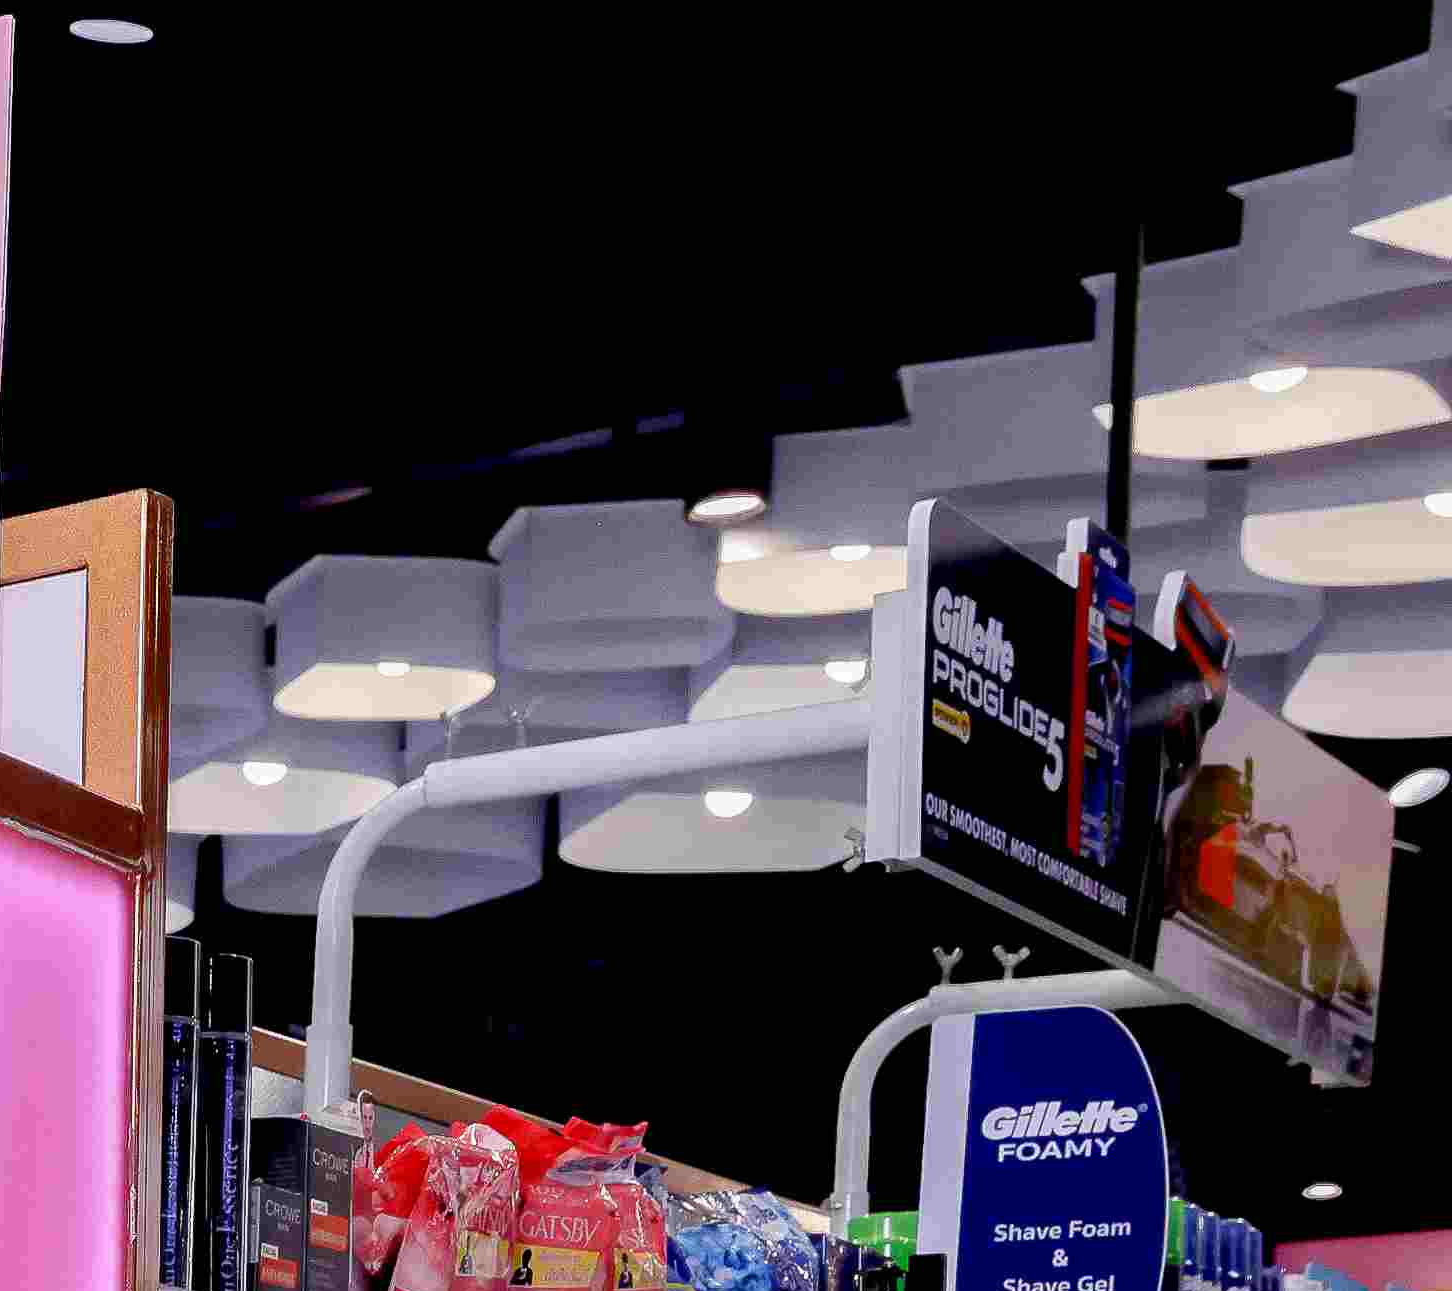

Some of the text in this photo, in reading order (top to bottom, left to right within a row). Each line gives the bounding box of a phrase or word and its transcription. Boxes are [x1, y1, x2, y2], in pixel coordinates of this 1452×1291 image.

[932, 586, 1014, 682] Gillette
[925, 793, 948, 822] OUR
[1010, 836, 1036, 868] MOST
[981, 1099, 1140, 1140] Gillette
[997, 1137, 1117, 1162] FOAMY
[518, 1209, 605, 1246] GATSBY
[993, 1218, 1132, 1243] Shave Foam
[1052, 1249, 1069, 1267] &
